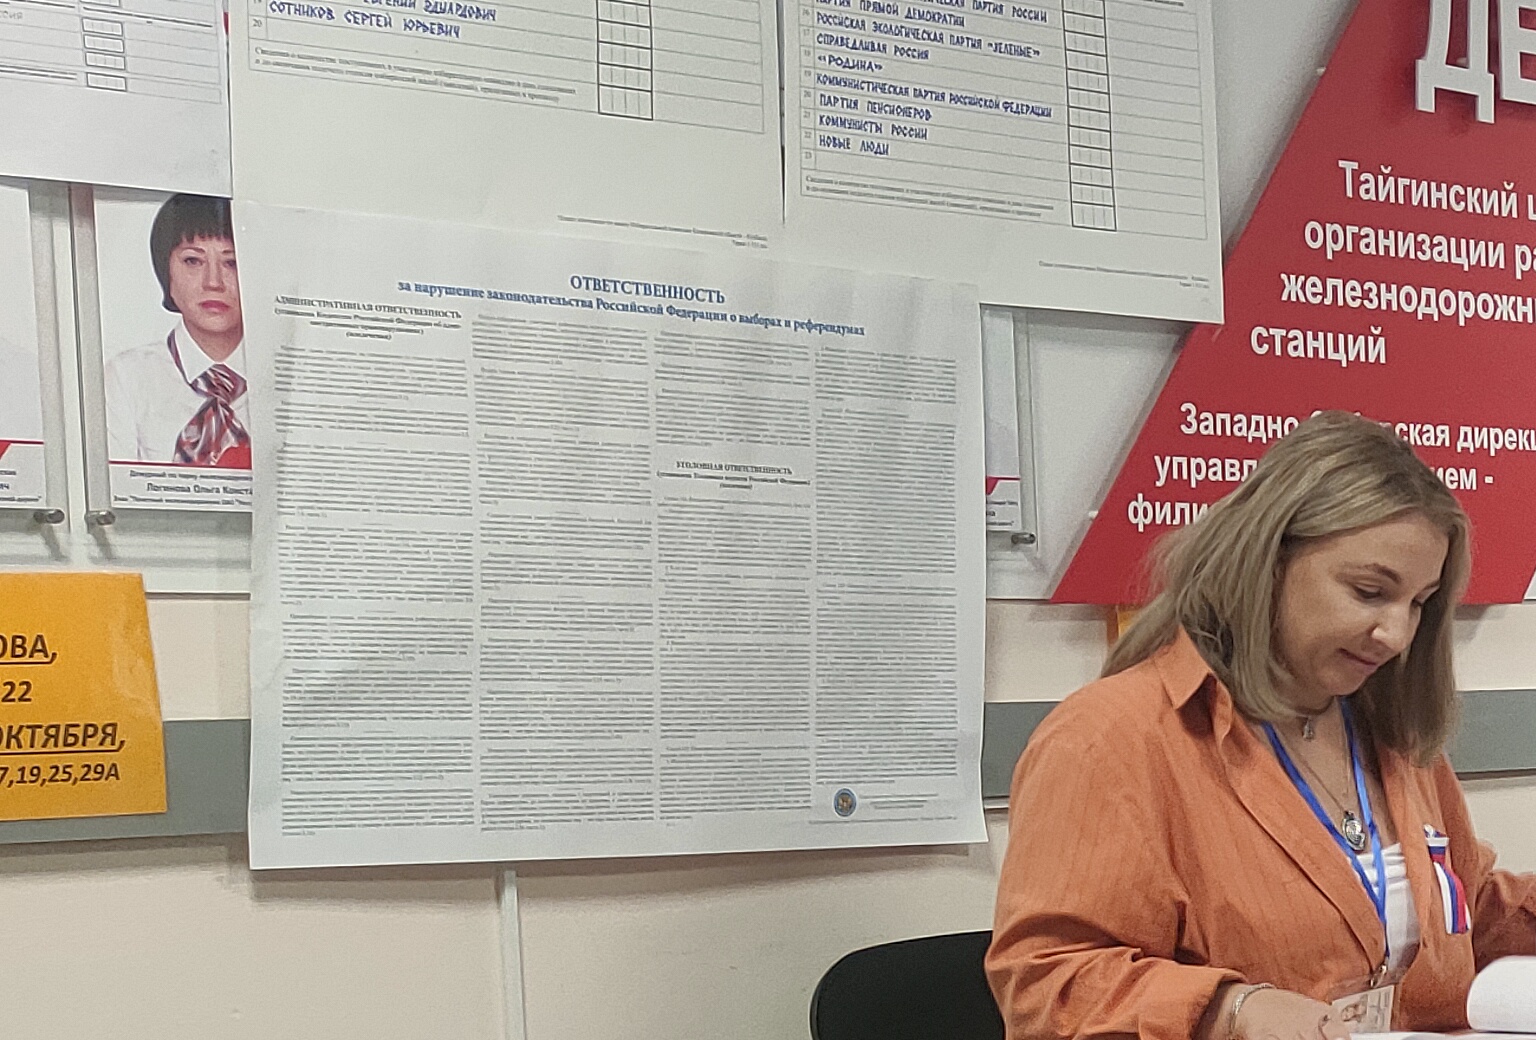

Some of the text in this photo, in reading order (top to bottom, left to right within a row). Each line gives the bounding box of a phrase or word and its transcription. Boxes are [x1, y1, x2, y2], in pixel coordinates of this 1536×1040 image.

[269, 0, 460, 38] СОТНИКОВ СЕРГЕЙ ЮРЬЕВИЧ
[1012, 6, 1048, 23] РОССИИ
[894, 44, 930, 60] РОССИЯ
[949, 34, 982, 50] ПАРТИЯ
[819, 93, 932, 121] ПАРТИЯ ПЕНСИОНЕРОВ
[819, 114, 928, 141] КОММУНИСТЫ РОССИИ
[819, 134, 889, 156] НОВЫЕ ЛЮДИ
[1338, 159, 1518, 219] Тайгинский
[1304, 218, 1505, 271] организации
[570, 274, 726, 304] ОТВЕТСТВЕННОСТЬ
[398, 280, 865, 337] за нарушение законодательства Российской Федерации о выборах и референдумах
[1250, 325, 1386, 368] станций
